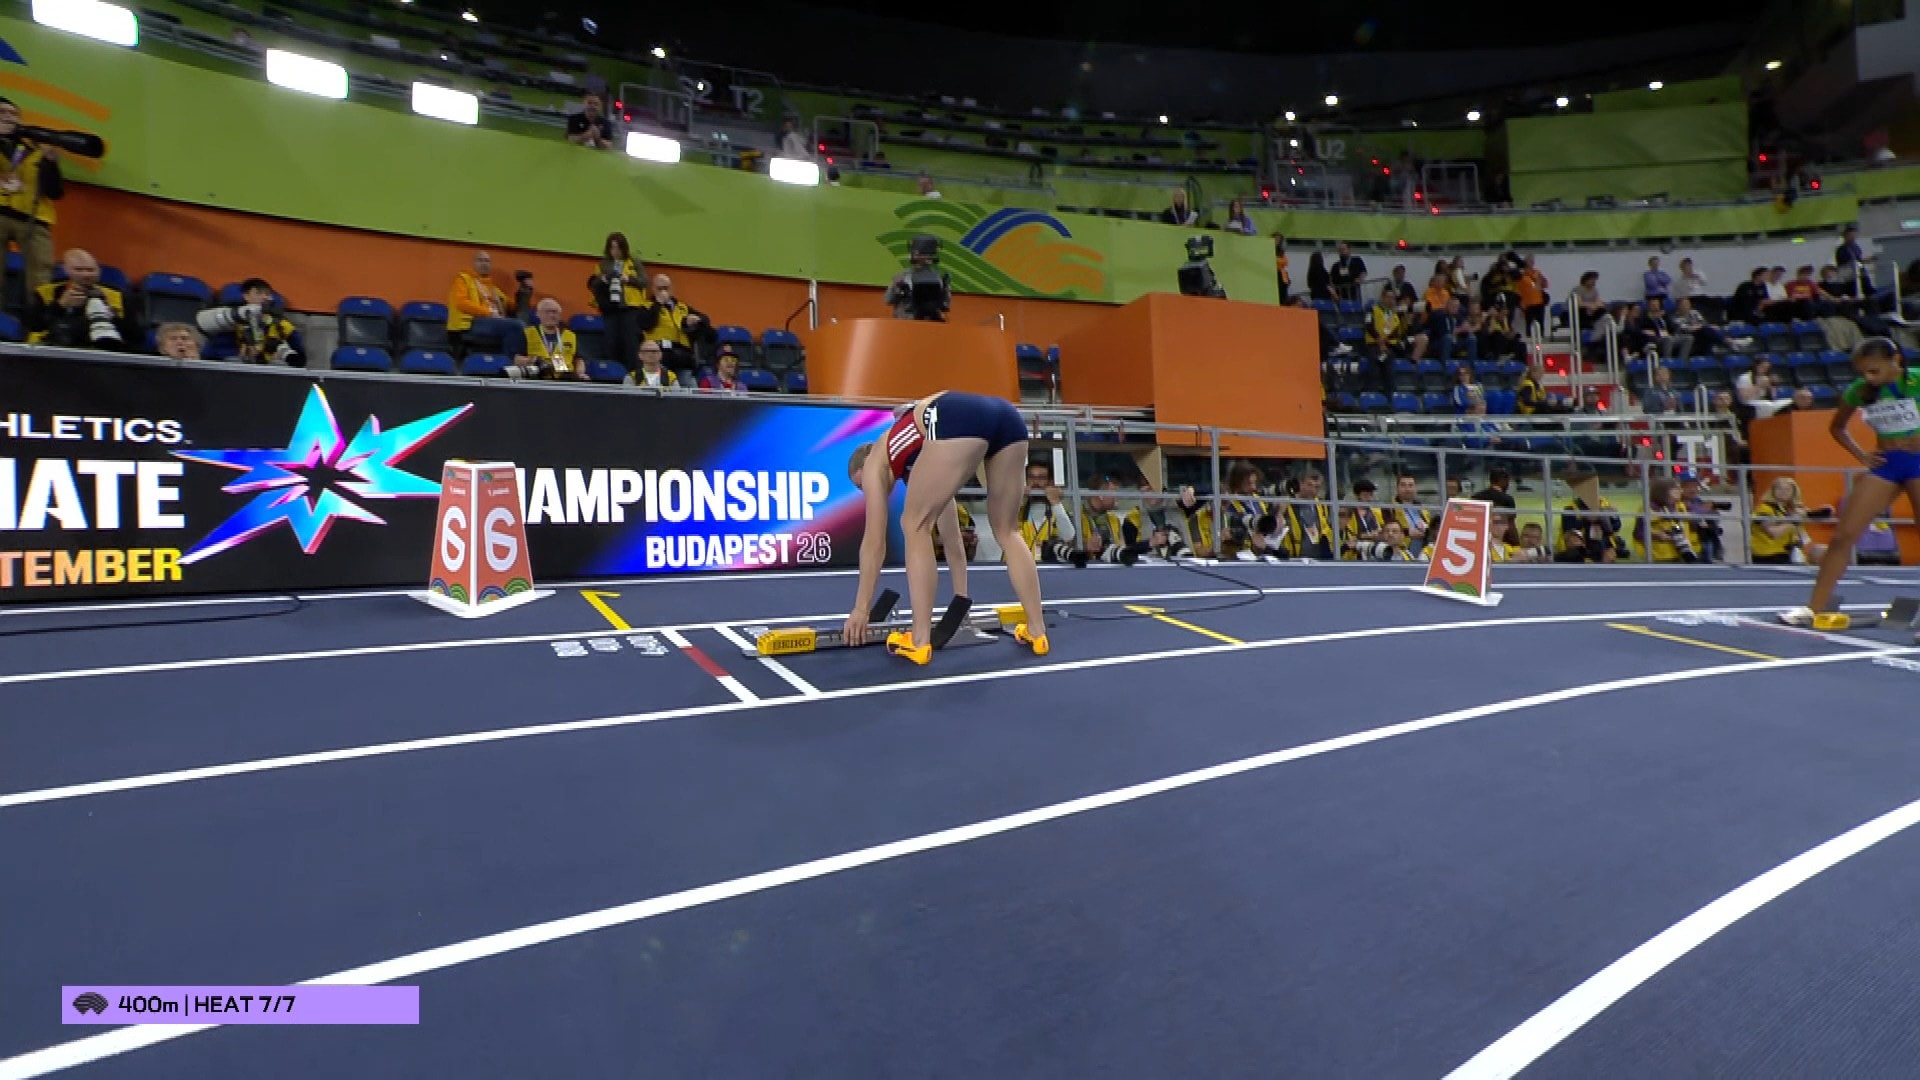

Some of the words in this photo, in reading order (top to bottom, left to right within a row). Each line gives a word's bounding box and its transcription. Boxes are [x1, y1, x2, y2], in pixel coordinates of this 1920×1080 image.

[729, 86, 764, 113] T2
[1677, 436, 1720, 478] T1
[441, 505, 467, 572] 6
[484, 506, 518, 572] 6
[646, 534, 793, 568] BUDAPEST
[796, 532, 832, 563] 26
[1441, 528, 1477, 575] 5
